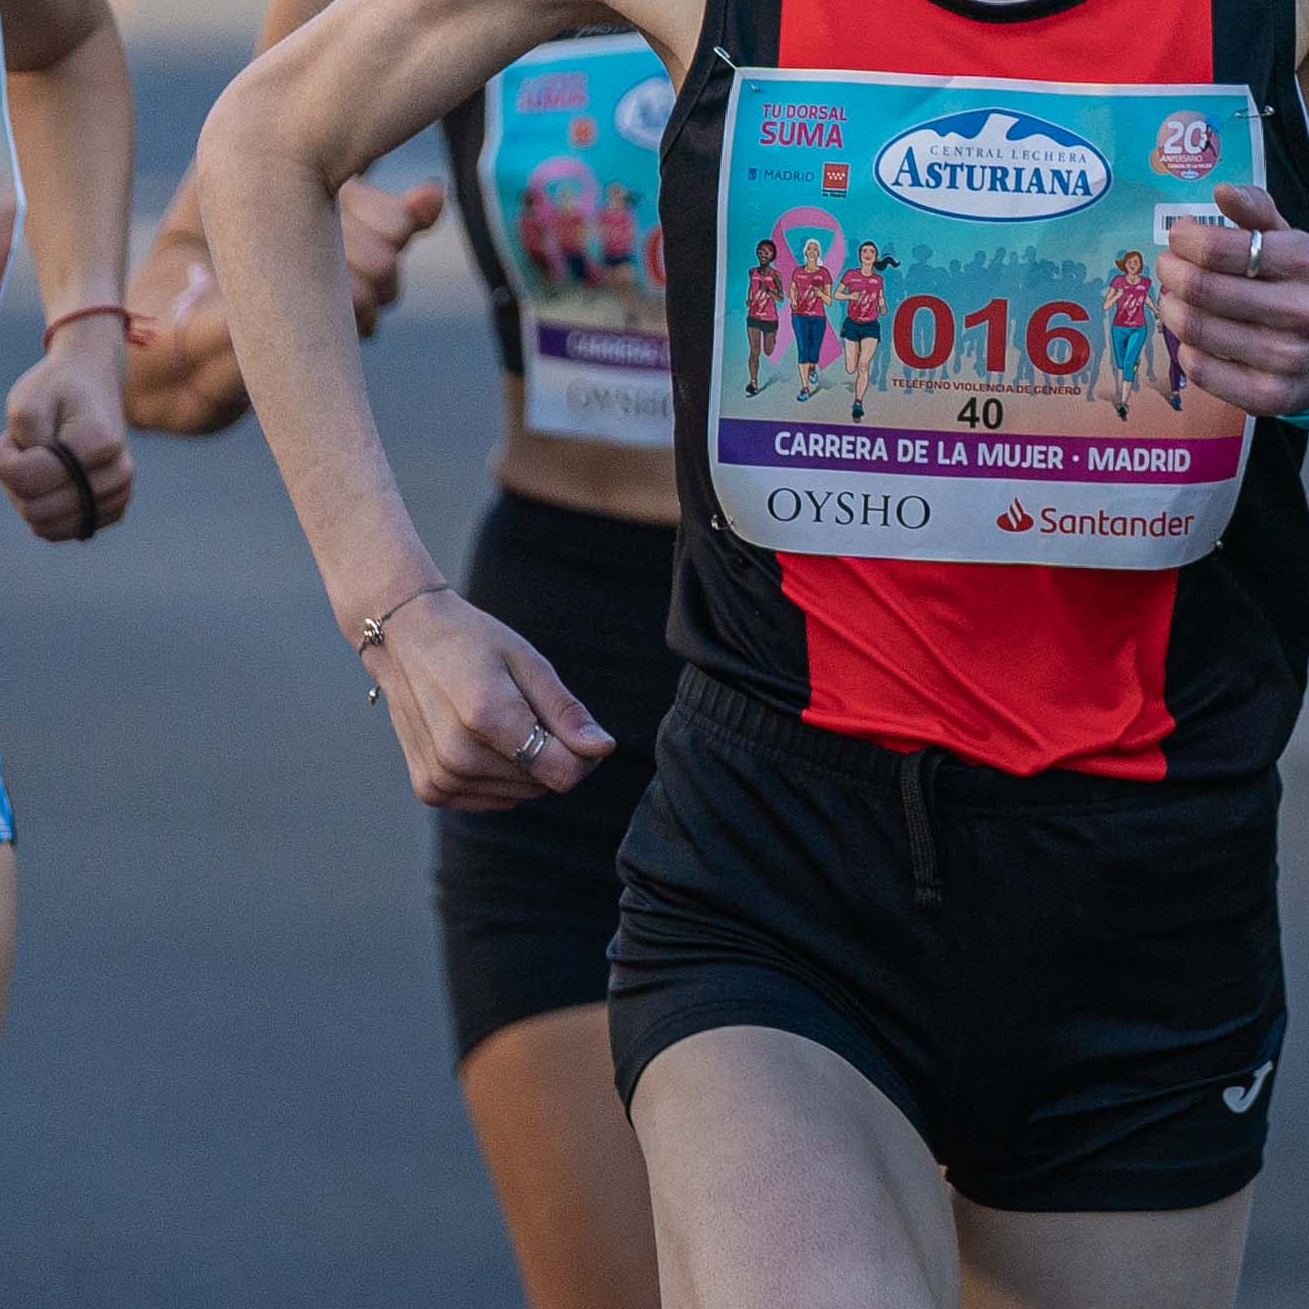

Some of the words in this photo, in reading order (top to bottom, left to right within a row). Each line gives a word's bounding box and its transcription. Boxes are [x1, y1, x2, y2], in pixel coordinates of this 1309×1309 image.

[763, 104, 782, 118] TU
[786, 105, 847, 121] DORSAL
[760, 121, 843, 149] SUMA
[1163, 120, 1208, 154] 20
[930, 145, 1003, 159] CENTRAL
[1011, 148, 1087, 164] LECHERA
[764, 168, 814, 183] MADRID
[892, 146, 1093, 197] ASTURIANA
[893, 295, 1090, 375] 016
[953, 382, 1013, 393] VIOLENCIA
[1017, 384, 1031, 394] DE
[957, 397, 1004, 430] 40
[774, 431, 888, 462] CARRERA
[897, 439, 929, 464] DE
[937, 441, 968, 466] LA
[977, 443, 1063, 470] MUJER
[1088, 447, 1191, 472] MADRID
[767, 487, 931, 530] OYSHO
[1040, 507, 1194, 538] Santander
